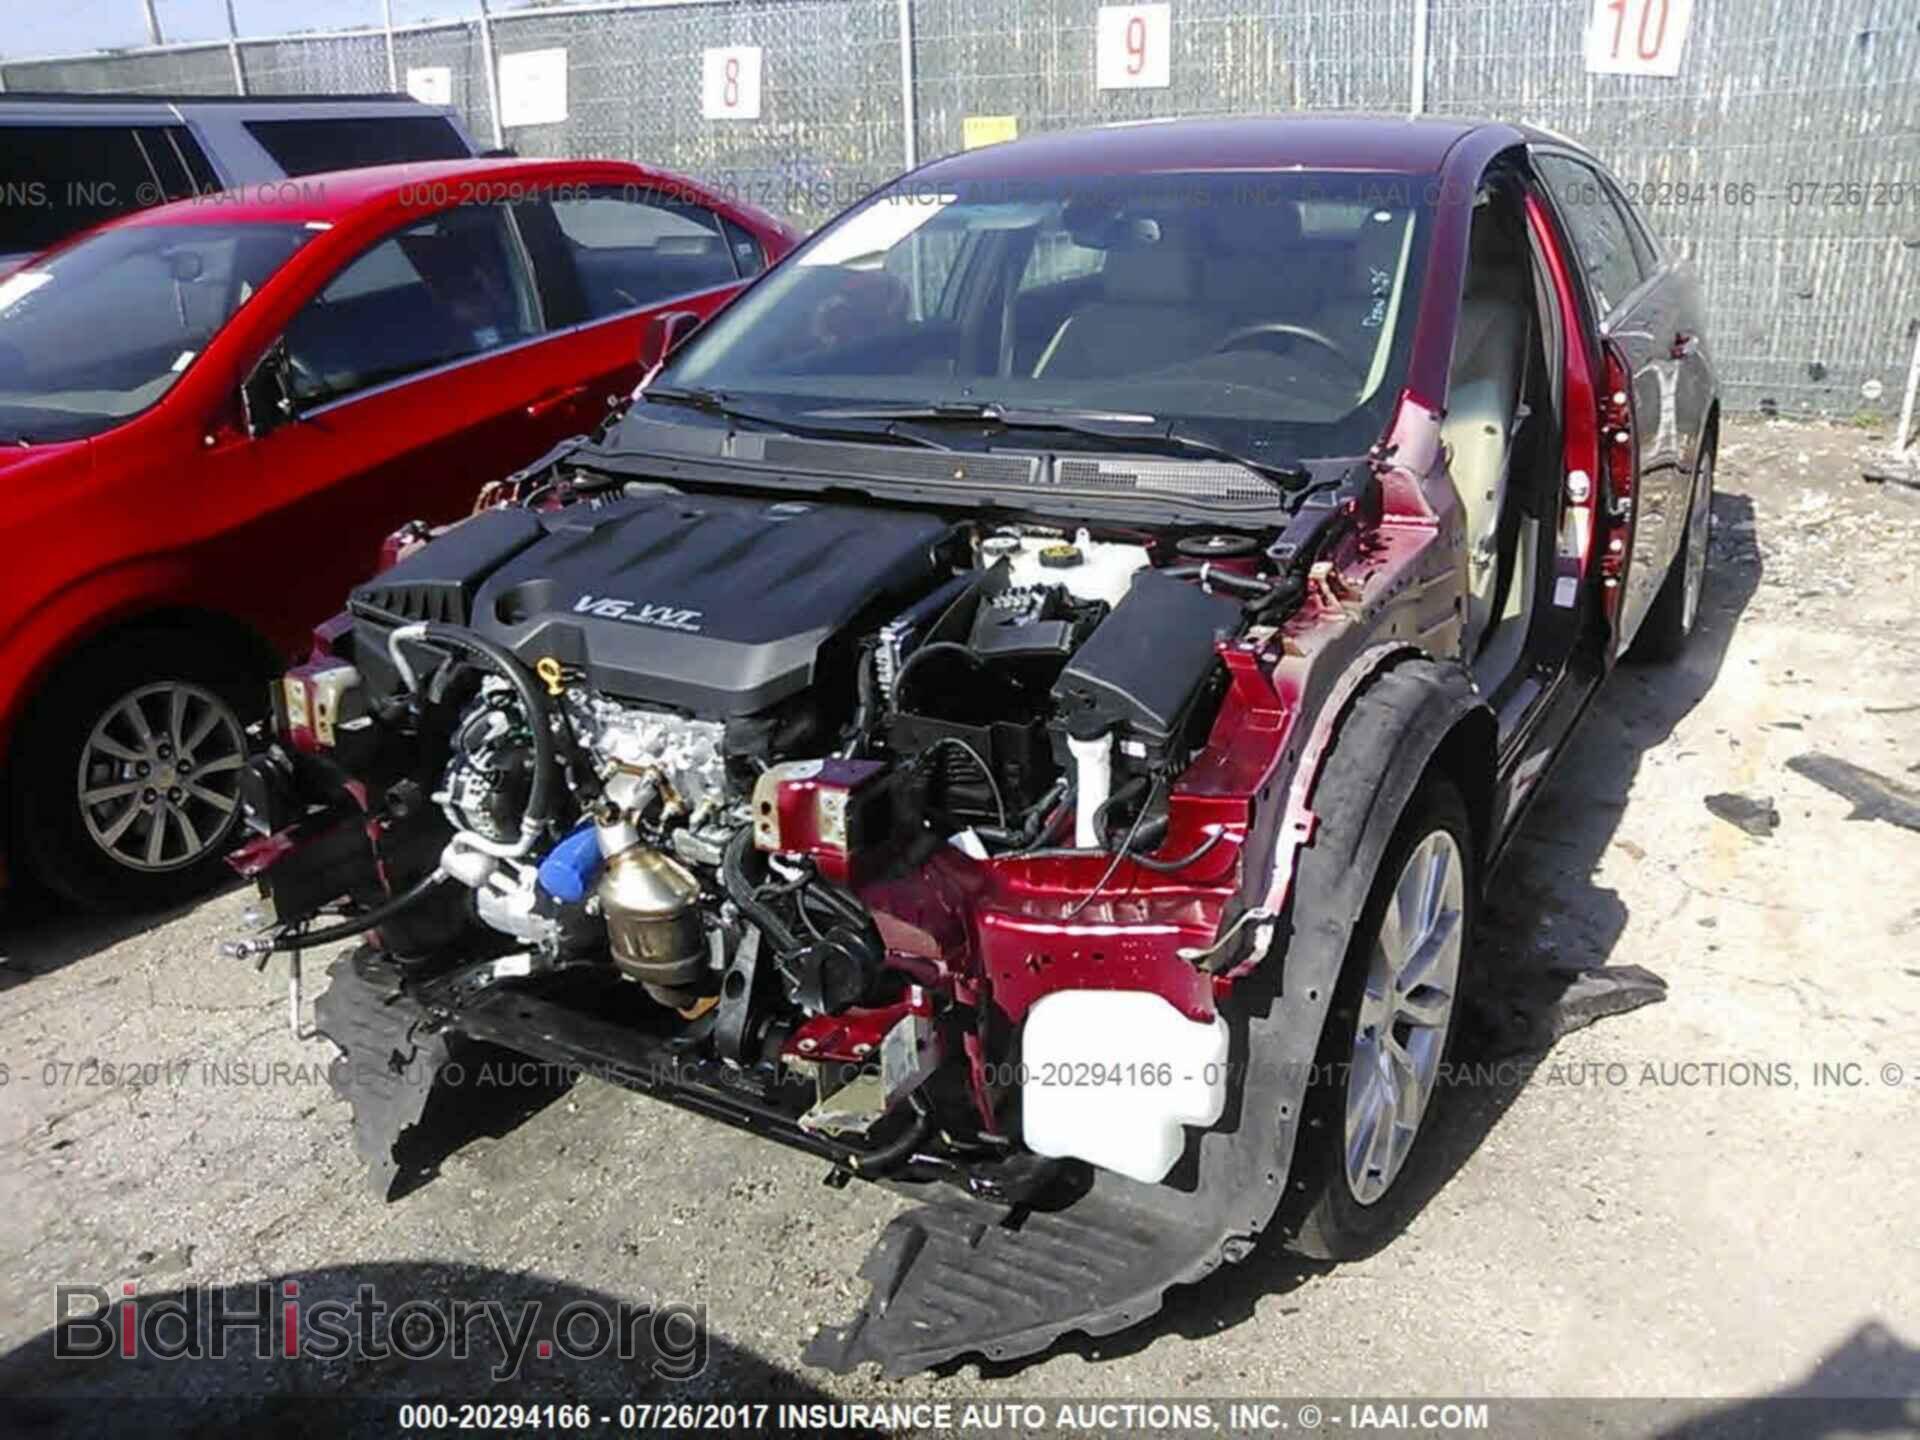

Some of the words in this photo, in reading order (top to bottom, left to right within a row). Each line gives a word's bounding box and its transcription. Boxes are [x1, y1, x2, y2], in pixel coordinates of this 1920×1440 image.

[1125, 17, 1147, 75] 9
[1607, 0, 1669, 60] 10
[724, 57, 740, 108] 8
[573, 594, 635, 618] V6
